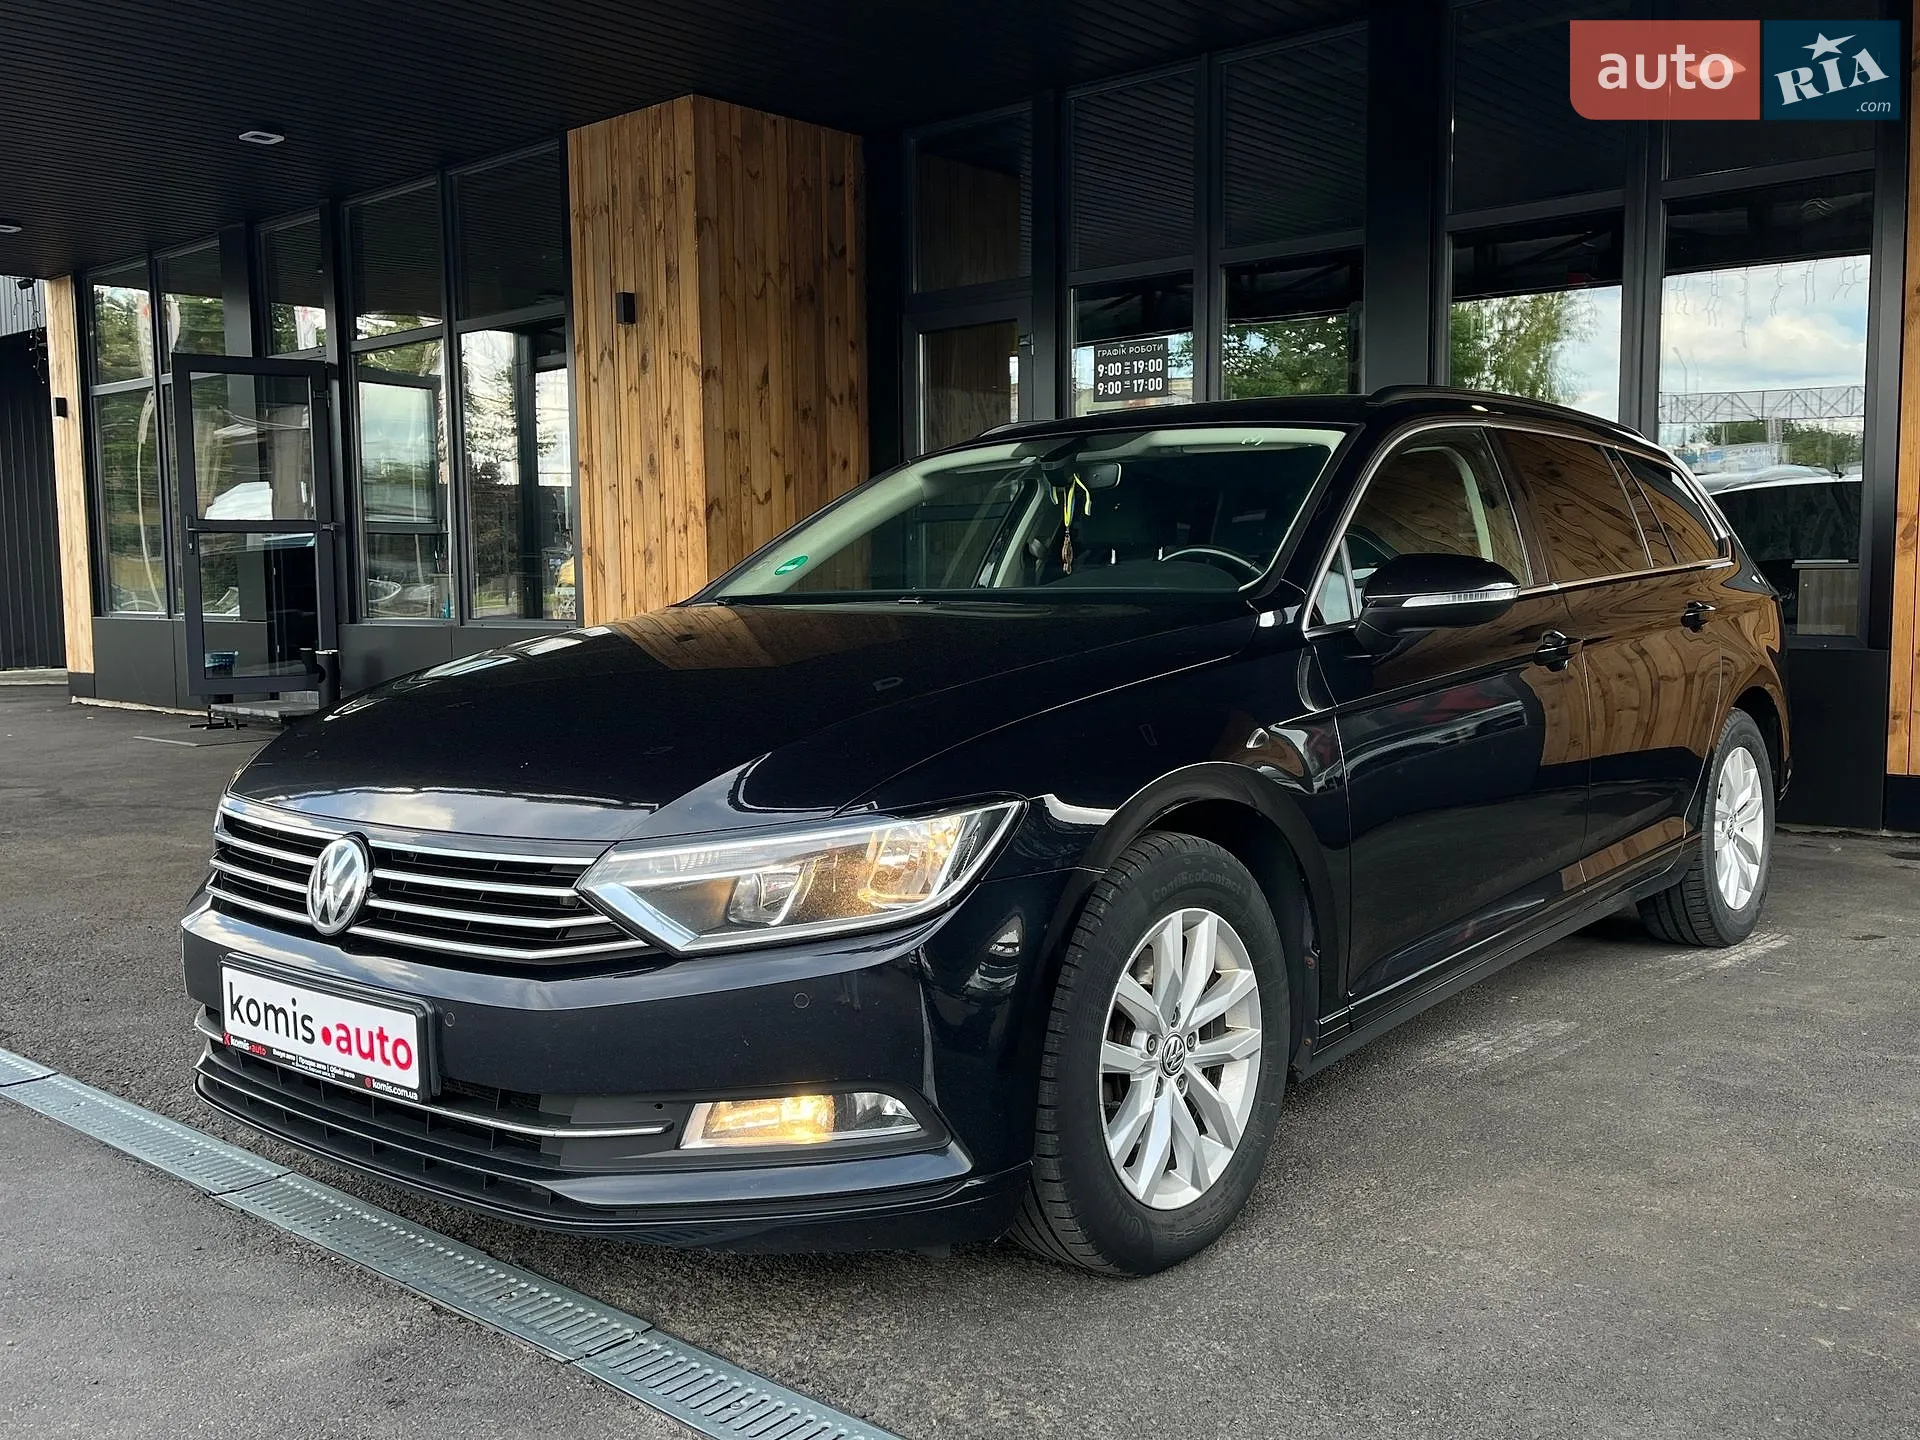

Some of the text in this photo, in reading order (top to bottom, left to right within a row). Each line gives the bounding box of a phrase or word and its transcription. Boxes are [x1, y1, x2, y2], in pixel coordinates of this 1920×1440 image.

[1097, 343, 1163, 358] ГРАФІК РОБОТИ
[1097, 358, 1163, 377] 9:00 19:00
[1097, 377, 1163, 396] 9:00 17:00
[372, 1078, 419, 1101] komis.com.ua
